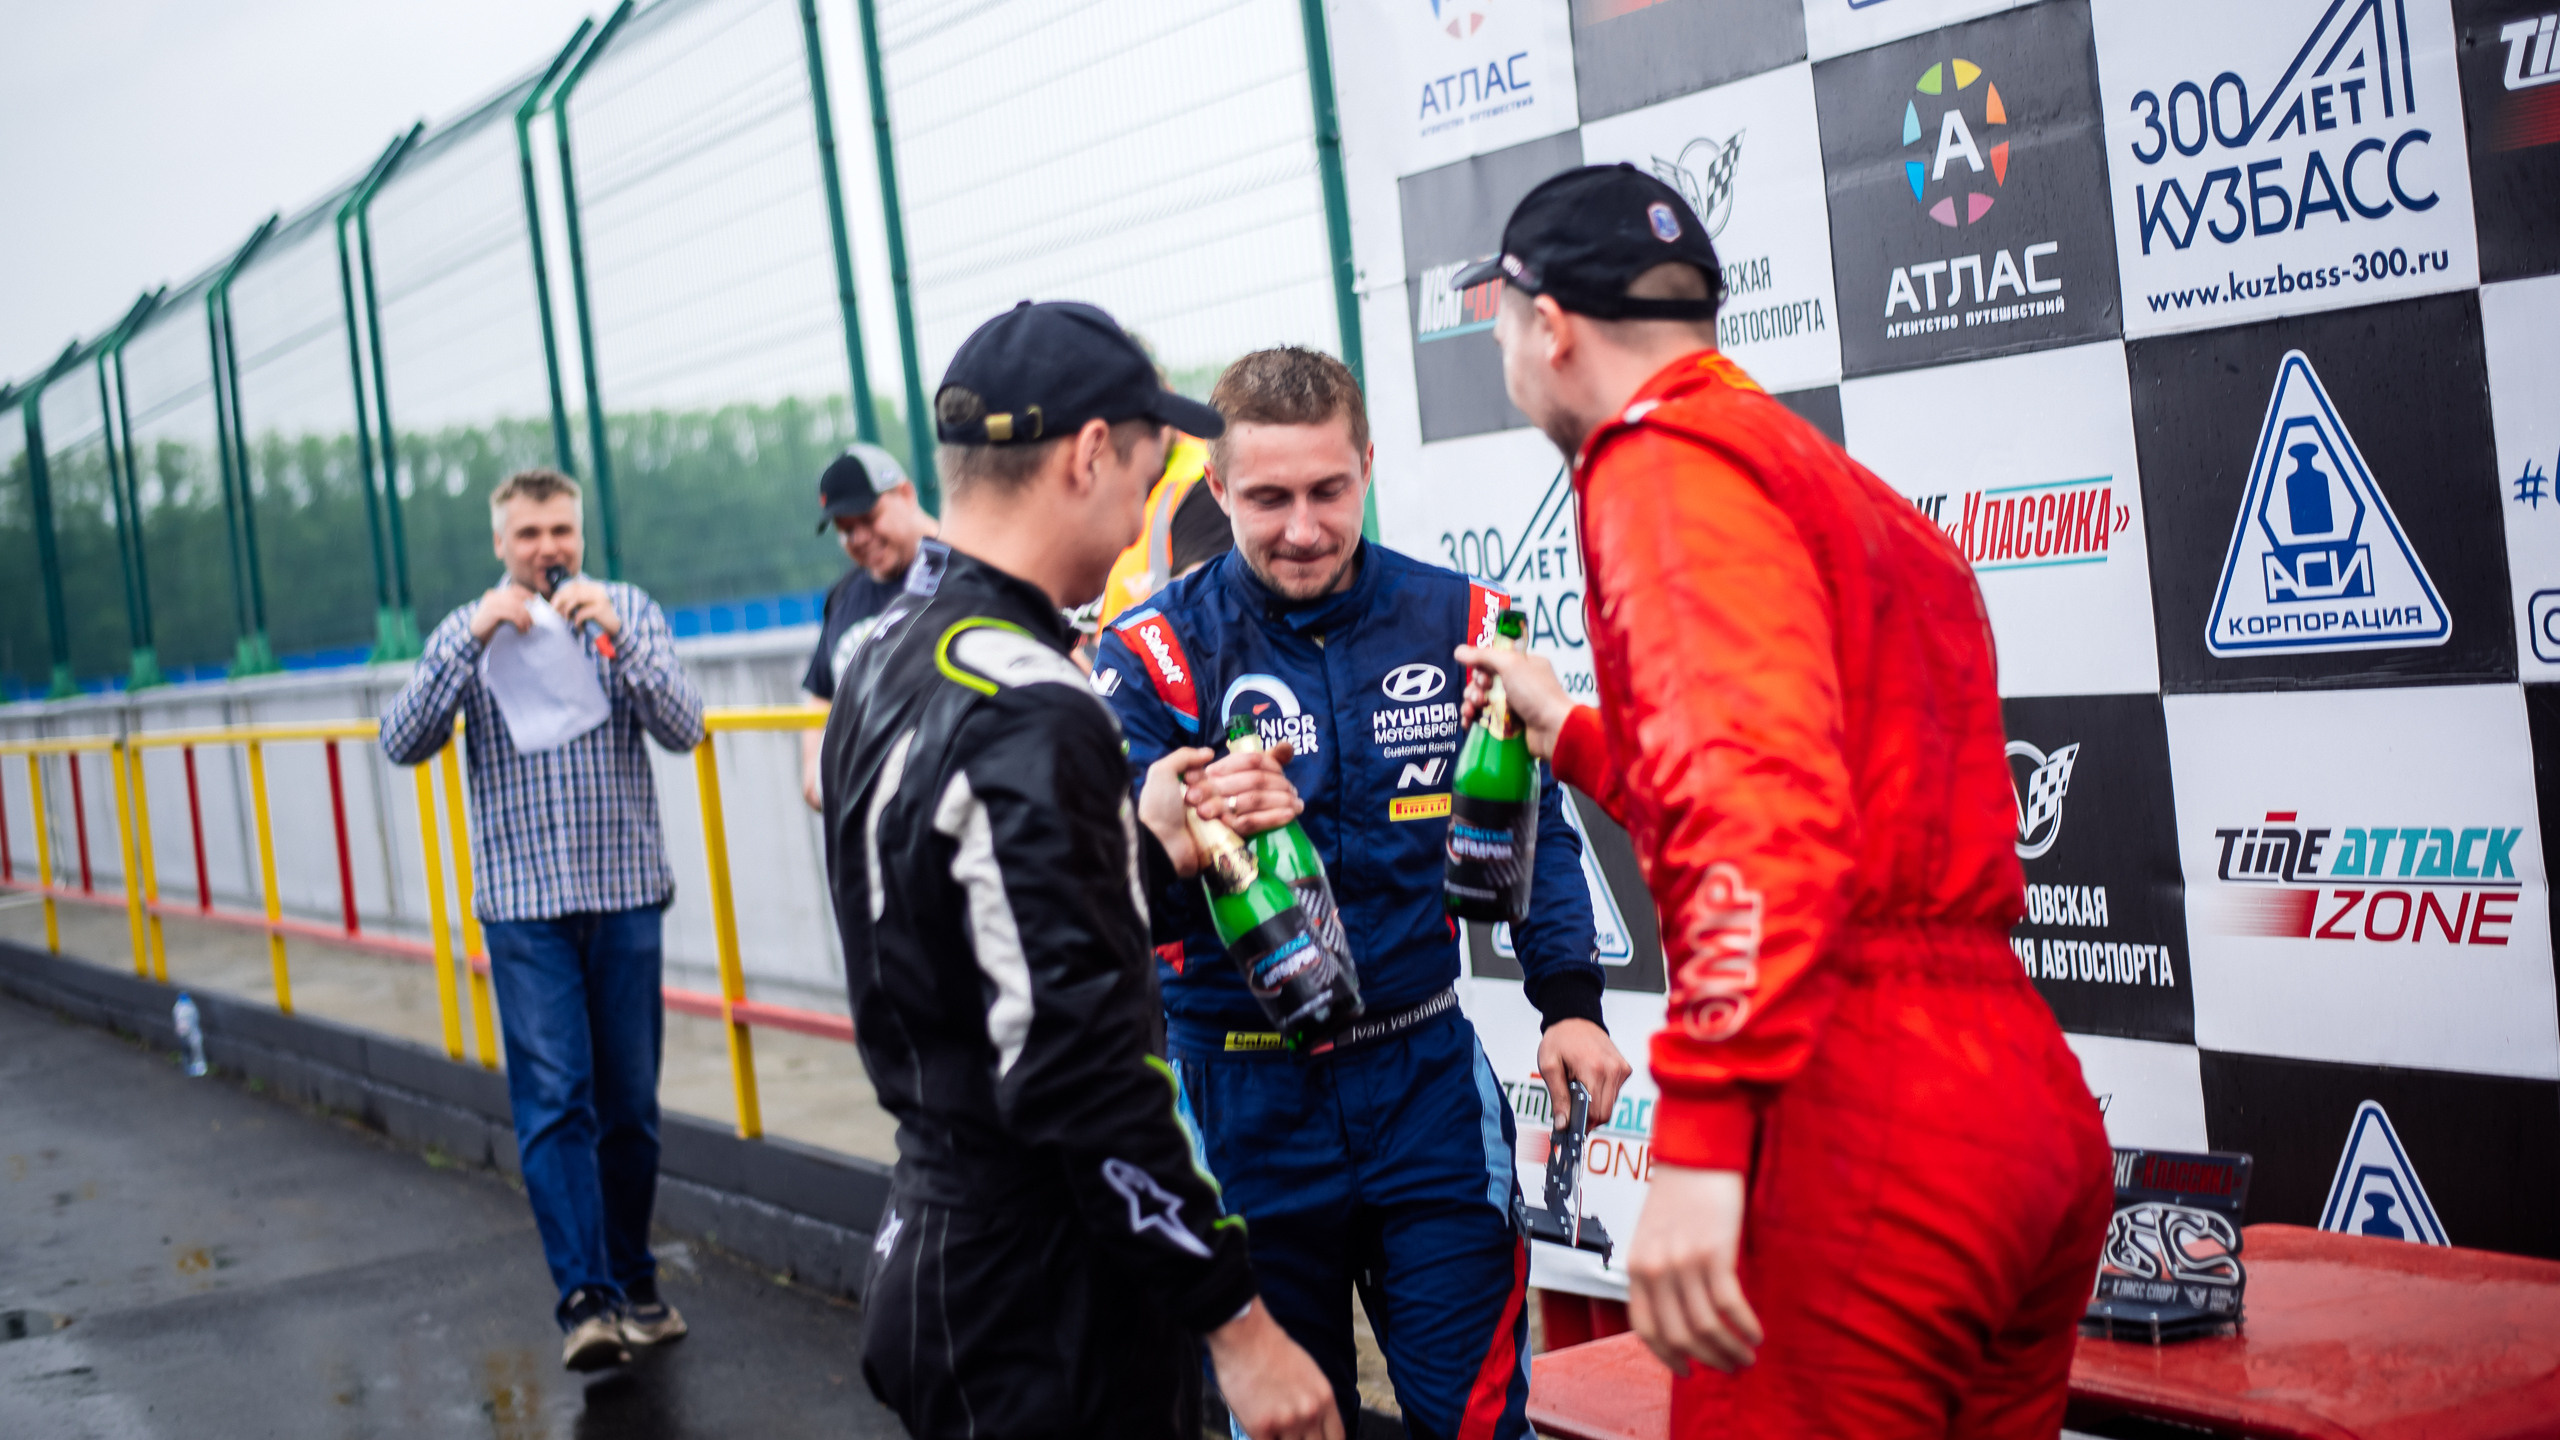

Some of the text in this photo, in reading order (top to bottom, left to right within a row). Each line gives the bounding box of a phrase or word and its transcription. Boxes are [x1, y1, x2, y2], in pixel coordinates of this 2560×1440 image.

[1420, 52, 1531, 120] АТЛАС
[2130, 71, 2366, 165] 300 ЛЕТ
[2136, 129, 2440, 256] КУЗБАСС
[1885, 241, 2062, 318] АТЛАС
[2147, 248, 2449, 313] www.kuzbass-300.ru
[1720, 298, 1825, 348] АВТОСПОРТА
[1887, 295, 2065, 339] АГЕНТСТВО ПУТЕШЕСТВИЙ
[2265, 547, 2371, 600] АСИ
[2229, 605, 2423, 637] КОРПОРАЦИЯ
[1256, 714, 1317, 738] NIOR
[1375, 721, 1458, 744] MOTORSPORT
[1384, 740, 1456, 759] Customer Racing
[2024, 883, 2109, 928] ОВСКАЯ
[2315, 889, 2519, 946] ZONE
[2041, 939, 2174, 987] АВТОСПОРТА
[1587, 1138, 1654, 1182] ON
